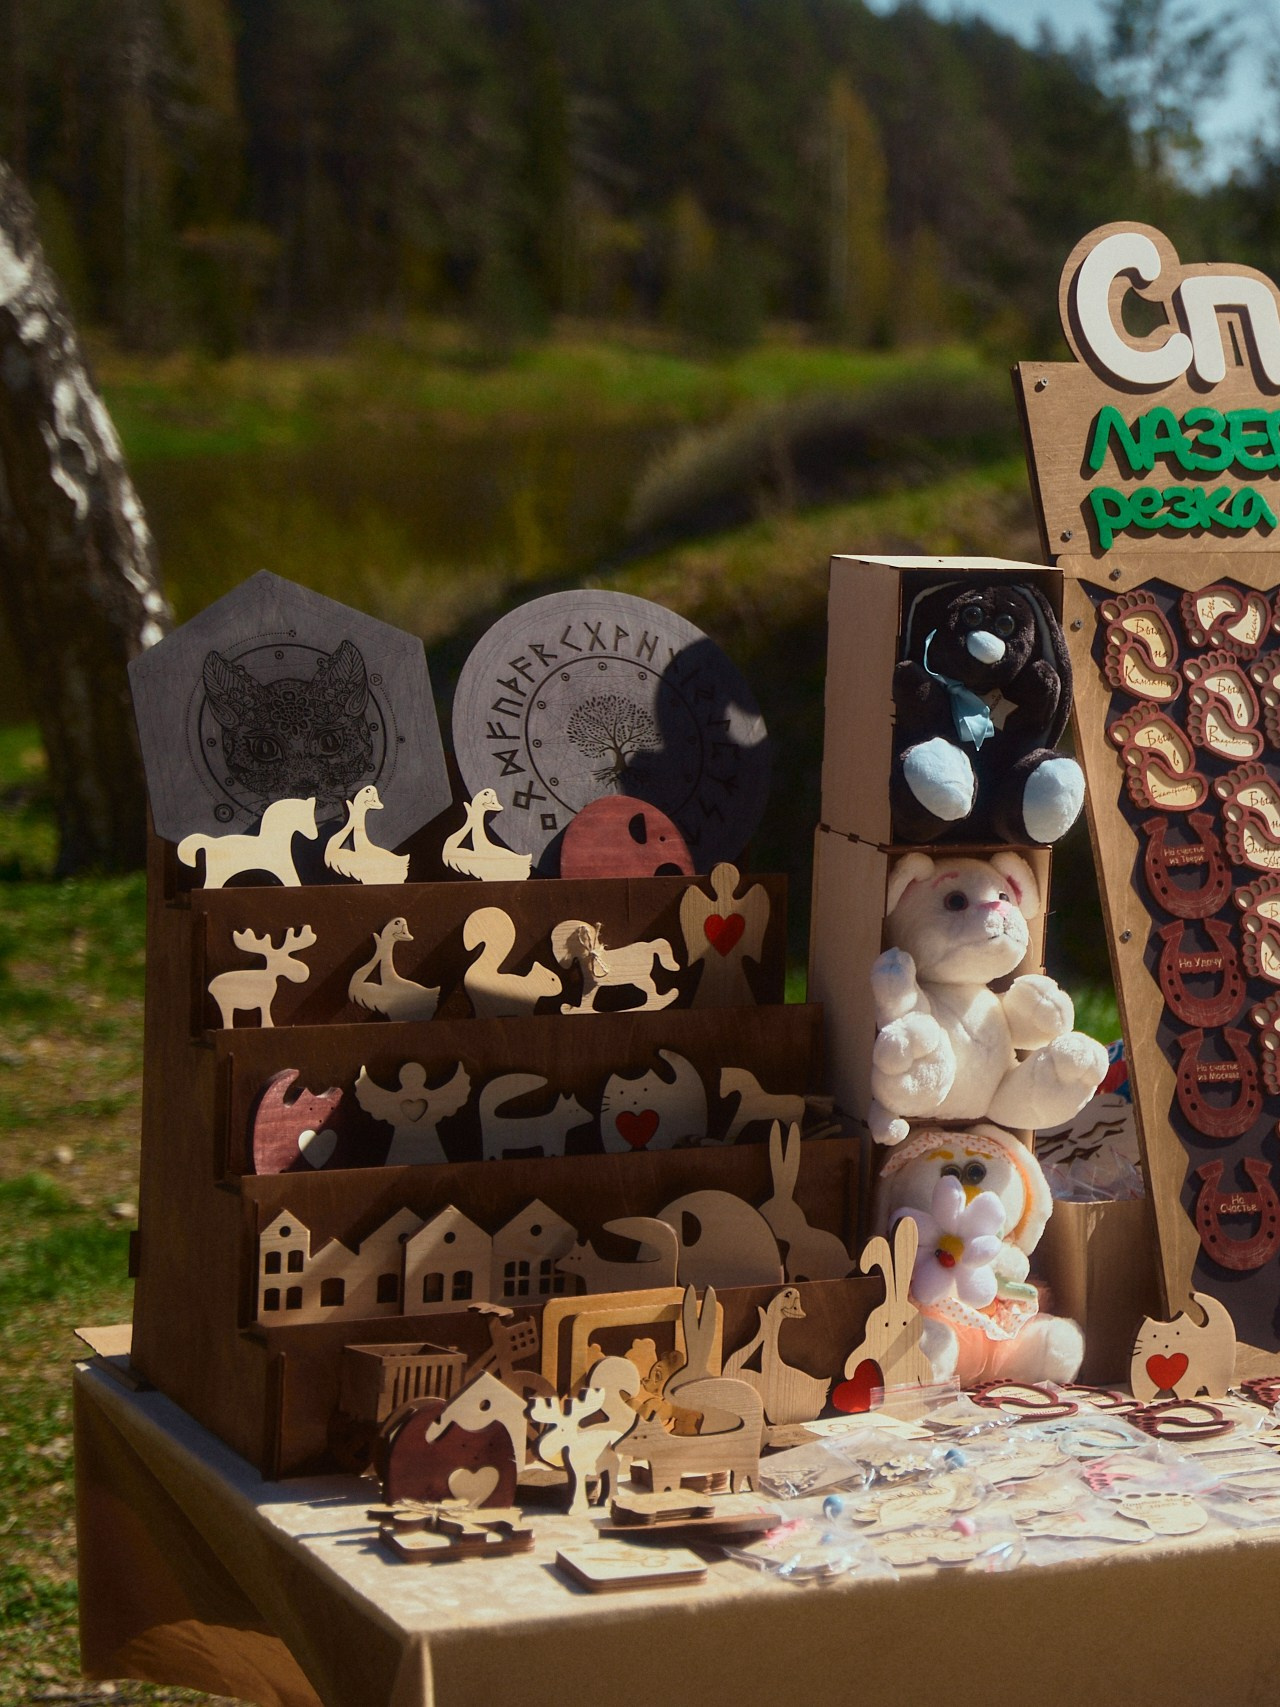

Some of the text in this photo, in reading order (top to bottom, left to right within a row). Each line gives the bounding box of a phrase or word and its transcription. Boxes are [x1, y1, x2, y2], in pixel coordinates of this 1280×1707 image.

[1090, 486, 1277, 549] резка
[1202, 595, 1215, 619] Был
[1135, 619, 1162, 635] Был
[1218, 680, 1244, 694] Был
[1146, 731, 1174, 745] Был
[1249, 791, 1276, 805] Был
[1182, 855, 1204, 864] Твери
[1179, 958, 1222, 968] На Удачу
[1232, 1196, 1245, 1205] На
[1220, 1204, 1257, 1213] Счастье
